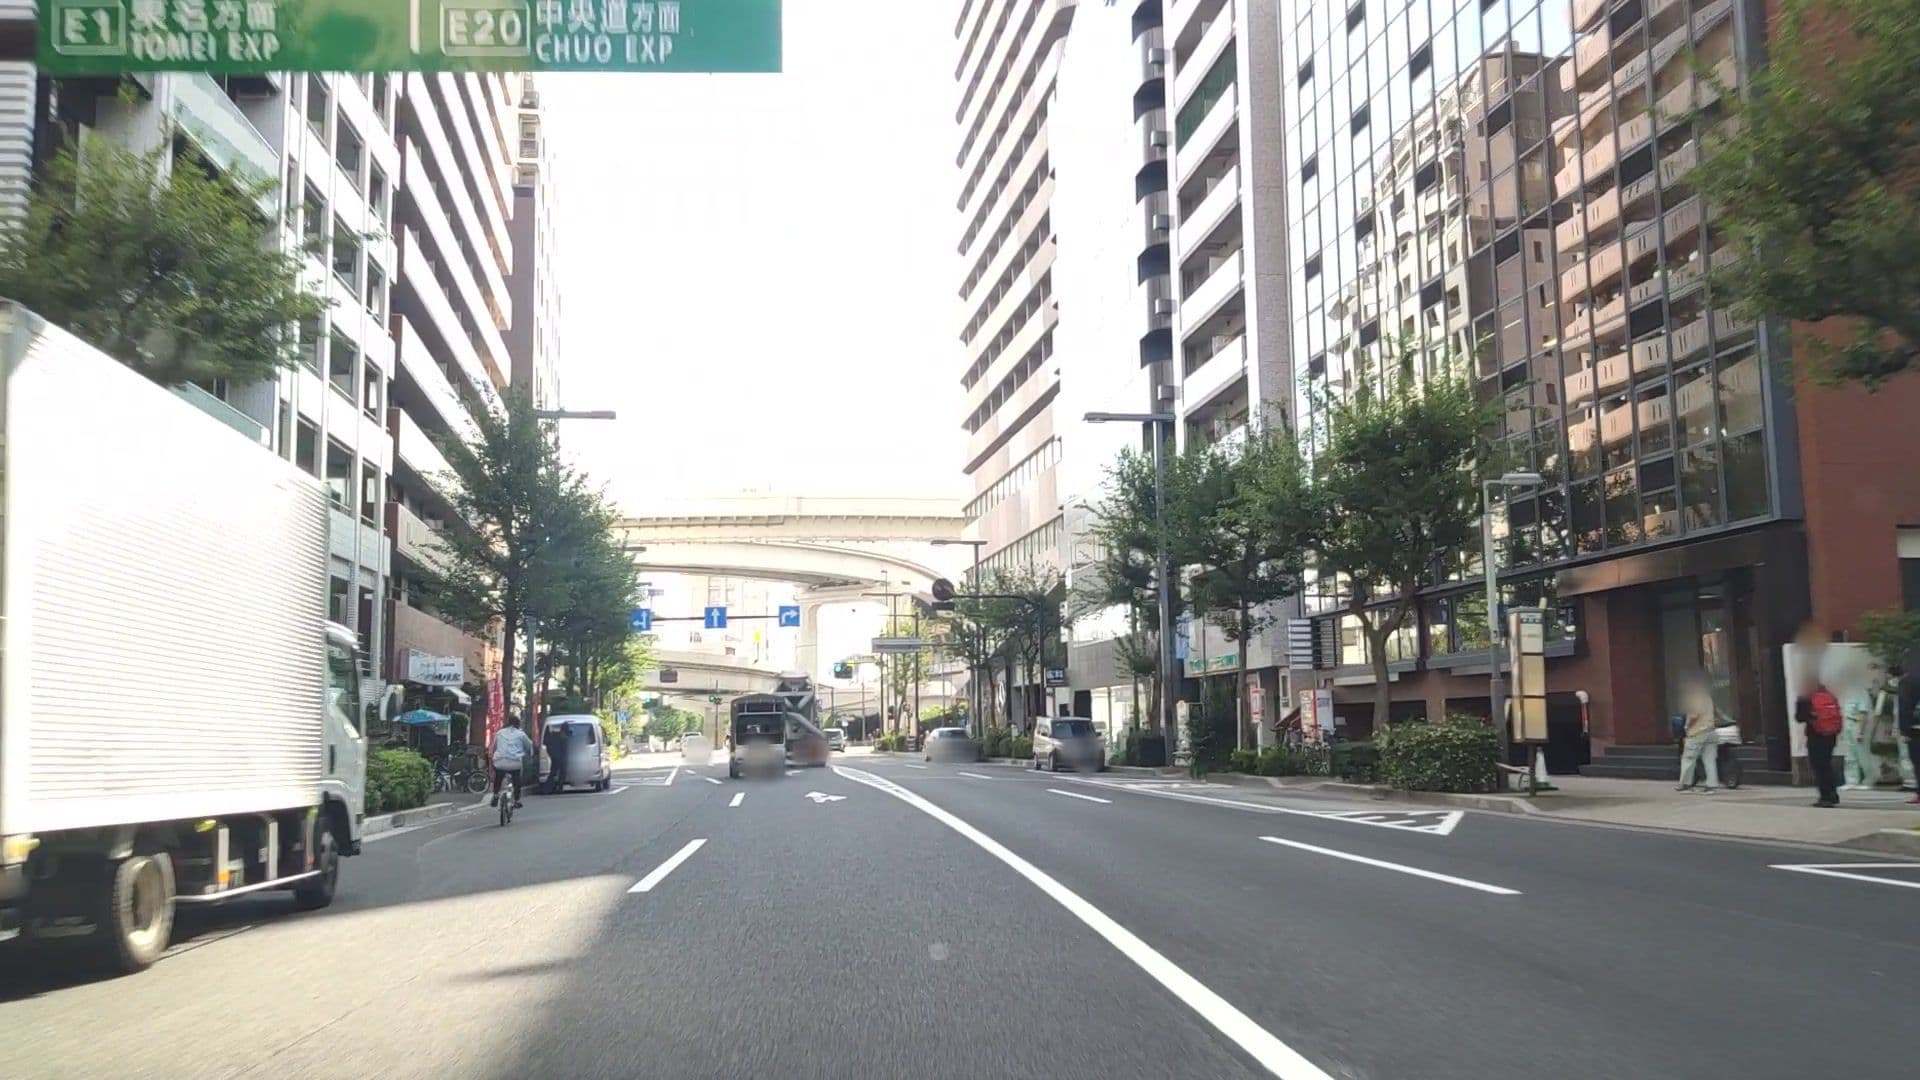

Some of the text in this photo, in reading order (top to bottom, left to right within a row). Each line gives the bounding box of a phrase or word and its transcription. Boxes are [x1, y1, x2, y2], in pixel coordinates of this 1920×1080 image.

[64, 8, 111, 44] E1
[130, 0, 276, 32] 東名方面
[449, 10, 522, 45] E20
[536, 0, 680, 33] 中央道方面
[130, 32, 280, 61] TOMEI EXP
[536, 34, 612, 63] CHUO
